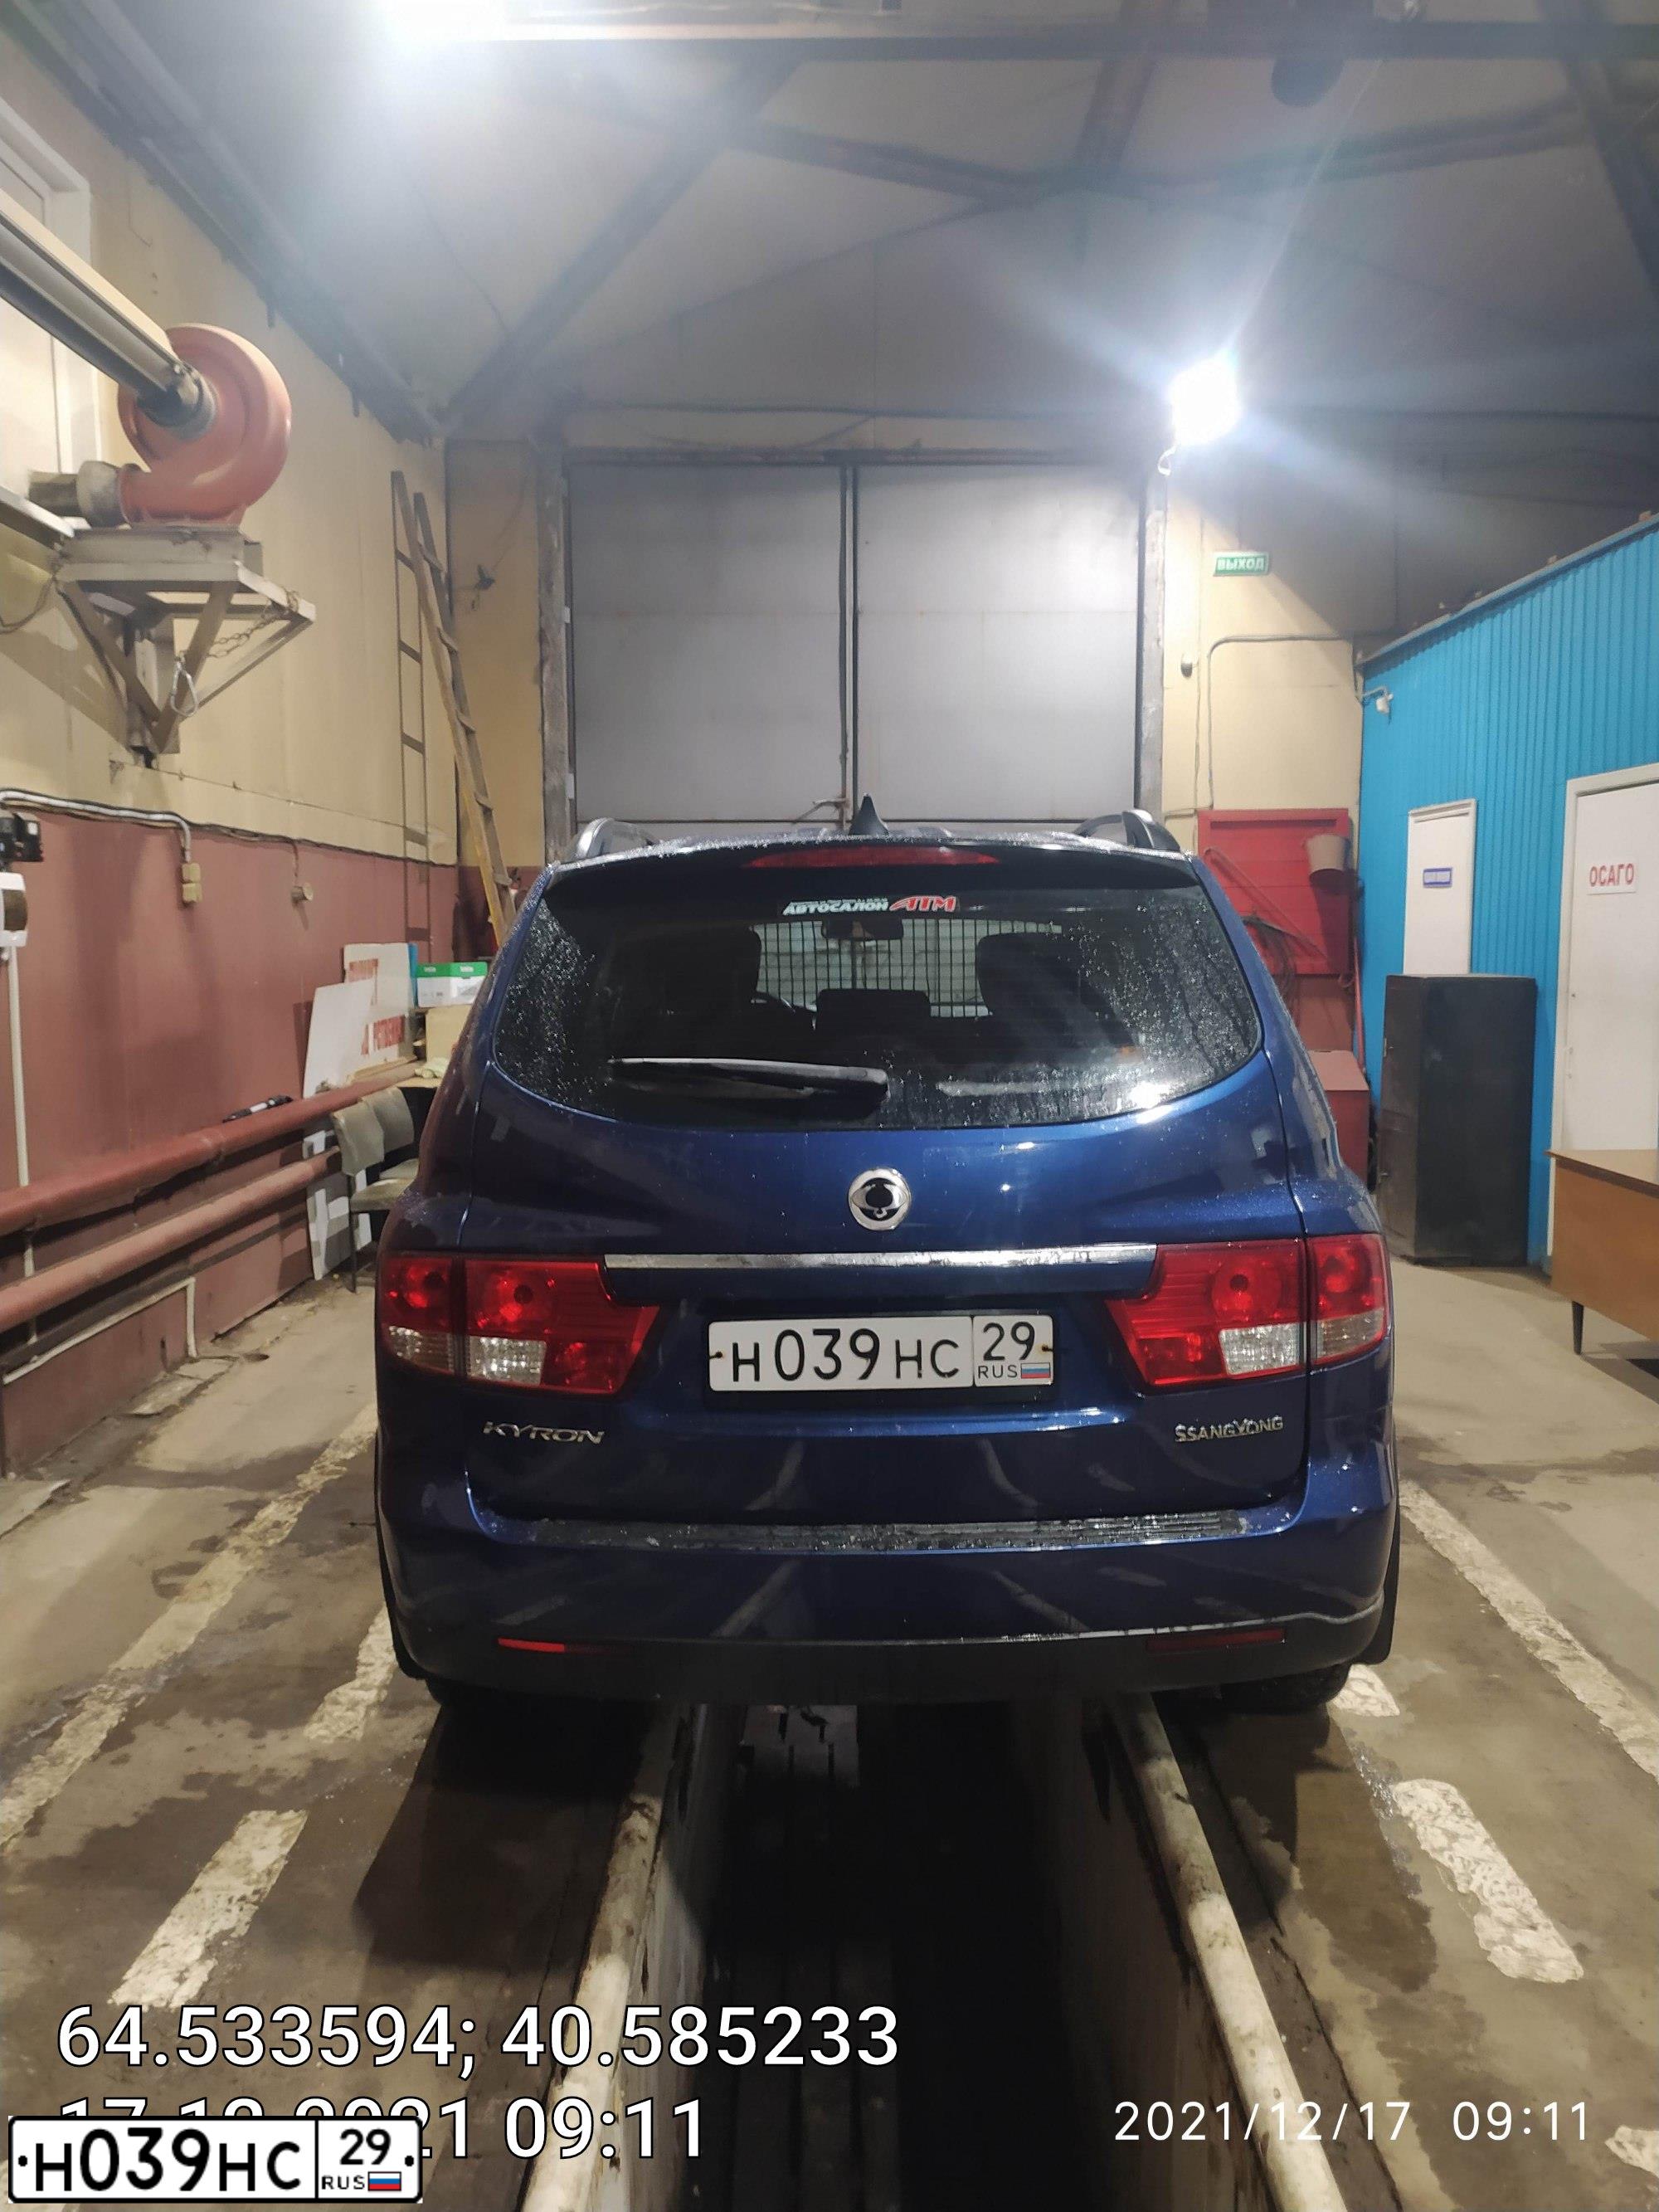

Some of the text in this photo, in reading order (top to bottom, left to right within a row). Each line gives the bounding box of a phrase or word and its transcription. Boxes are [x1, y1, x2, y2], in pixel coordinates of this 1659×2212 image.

[1217, 557, 1265, 571] ВЫХОД
[1588, 863, 1635, 887] ОСАГО
[782, 900, 889, 915] АВТОСАЛОН
[982, 1321, 1036, 1361] 29
[977, 1364, 1019, 1379] RUS
[483, 1421, 605, 1445] KYRON
